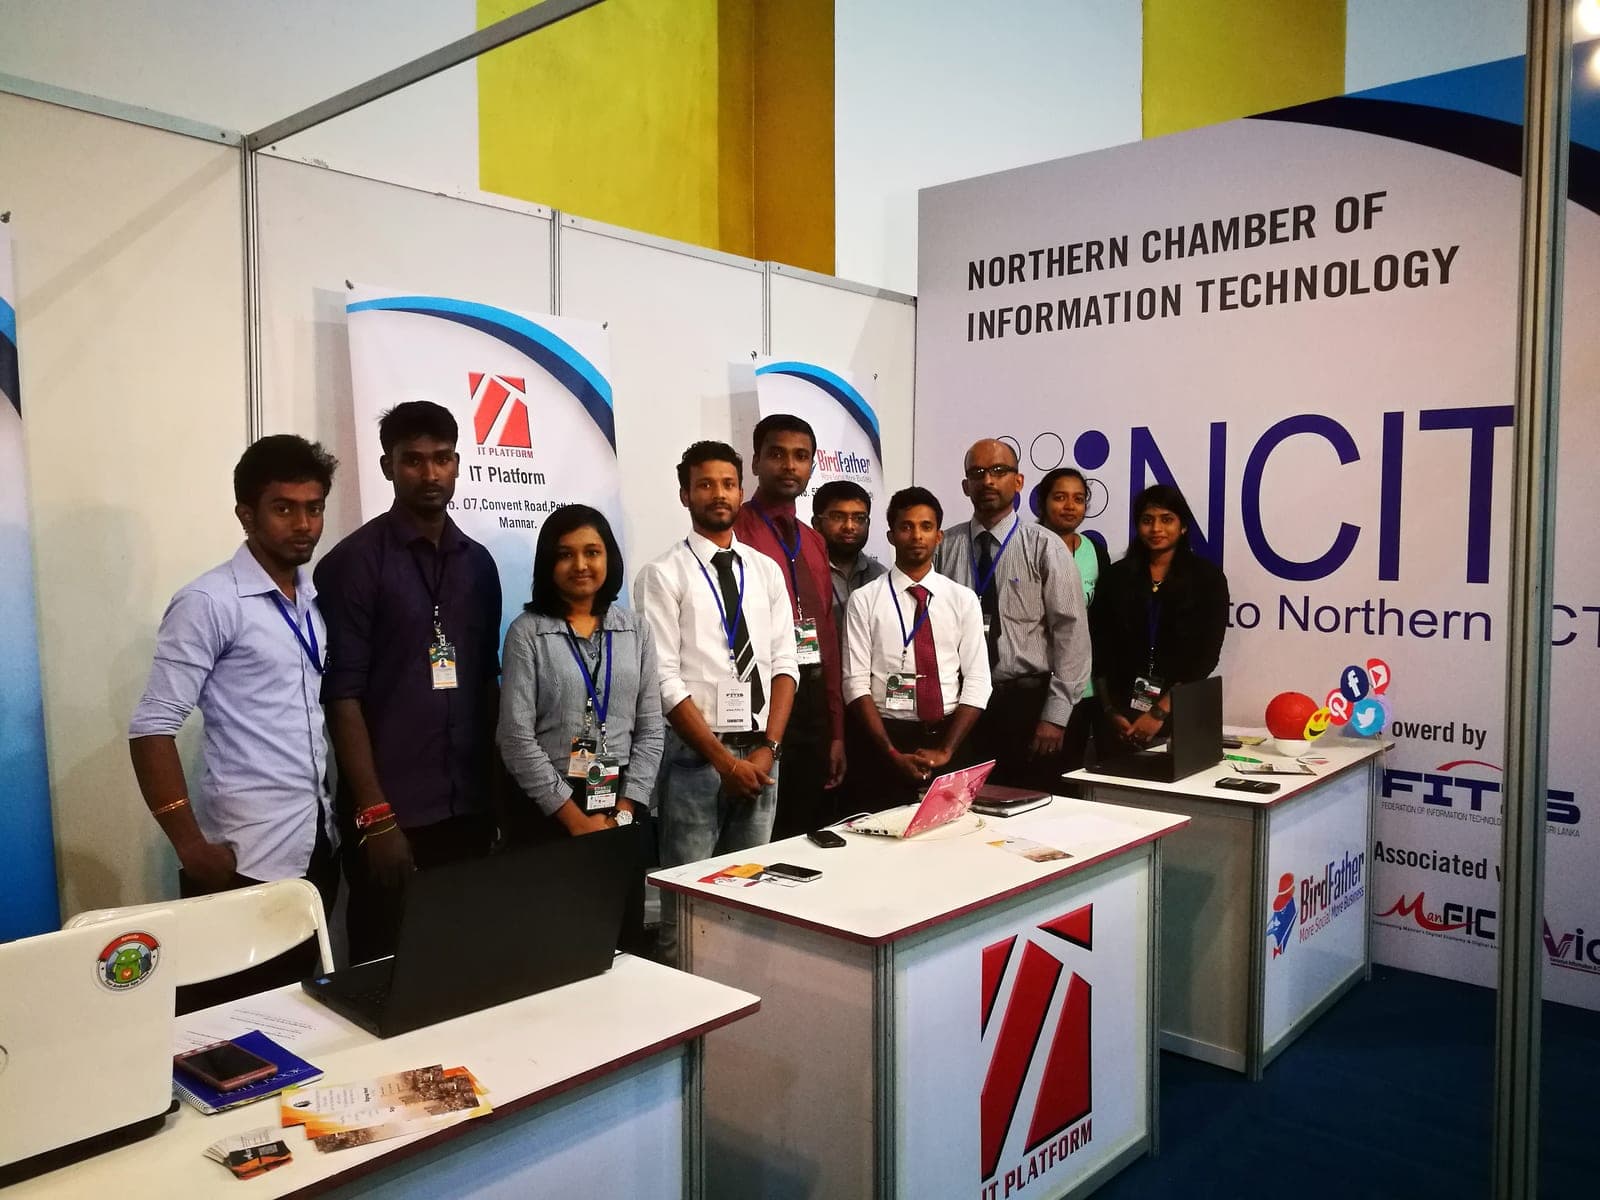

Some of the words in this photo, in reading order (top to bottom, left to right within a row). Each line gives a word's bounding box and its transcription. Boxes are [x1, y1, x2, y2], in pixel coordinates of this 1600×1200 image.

[968, 235, 1128, 290] NORTHERN
[1142, 204, 1316, 264] CHAMBER
[1335, 190, 1387, 234] OF
[967, 283, 1181, 342] INFORMATION
[1195, 245, 1460, 313] TECHNOLOGY
[477, 447, 486, 455] IT
[489, 447, 534, 459] PLATFORM
[817, 449, 870, 474] BirdFather
[469, 465, 483, 482] IT
[488, 466, 546, 485] Platform
[1129, 405, 1514, 583] NCIT
[499, 516, 538, 530] Mannar.
[1278, 595, 1492, 642] Northern
[1391, 721, 1454, 743] owerd
[1462, 723, 1487, 750] by
[1381, 800, 1417, 815] FEDERATION
[1426, 807, 1468, 822] INFORMATION
[1469, 813, 1501, 826] TECHNOLO
[1382, 768, 1581, 825] FITS
[1375, 841, 1488, 880] Associated
[1300, 850, 1365, 925] BirdFather
[1005, 1118, 1093, 1199] PLATFORM
